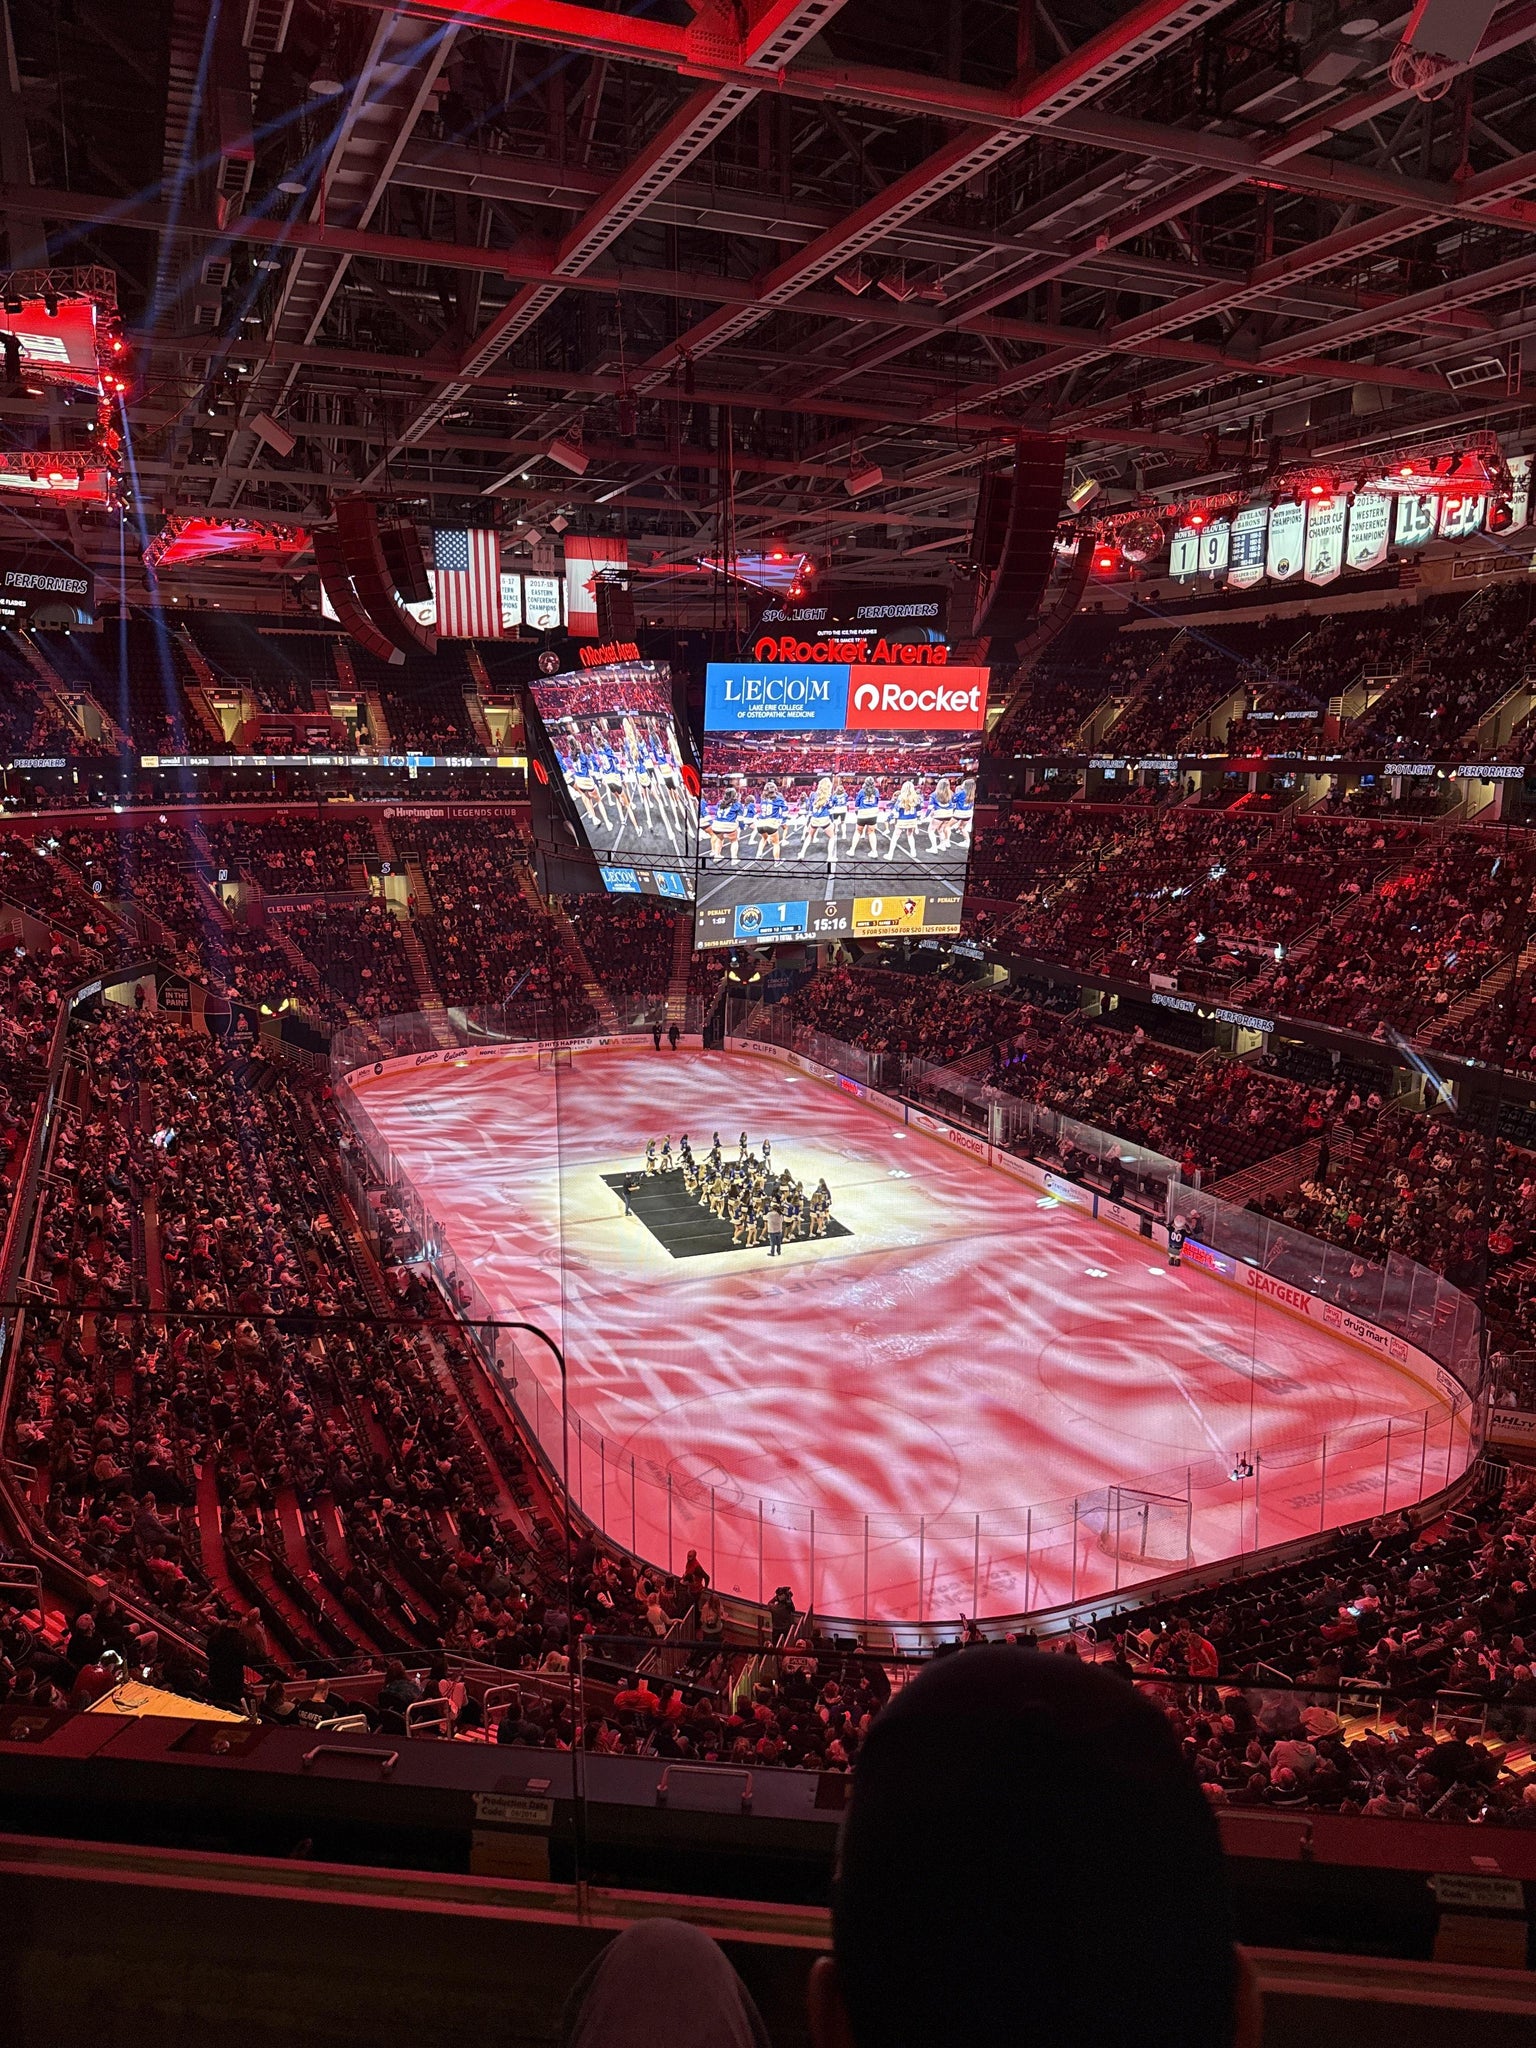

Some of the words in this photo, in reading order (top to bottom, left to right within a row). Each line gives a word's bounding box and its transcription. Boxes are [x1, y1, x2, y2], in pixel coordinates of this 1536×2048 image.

[1309, 515, 1331, 527] CALDER
[1332, 511, 1343, 522] CUP
[1356, 507, 1385, 519] WESTERN
[1403, 496, 1432, 533] 15
[1237, 518, 1261, 529] BARONS
[1271, 514, 1302, 527] CHAMPIONS
[1351, 518, 1388, 532] CONFERENCE
[1174, 529, 1197, 540] BOWER
[1202, 523, 1229, 534] GLOVER
[1308, 524, 1343, 539] CHAMPIONS
[1351, 530, 1385, 543] CHAMPIONS
[1180, 543, 1187, 570] 1
[1208, 537, 1218, 565] 9
[5, 572, 88, 595] PERFORMERS
[530, 580, 554, 588] 2017-18
[528, 604, 557, 612] CHAMPIONS
[762, 607, 828, 622] SPOLIGHT
[856, 603, 939, 619] PERFORMERS
[780, 637, 868, 663] Rocket
[871, 637, 949, 665] Arena
[881, 683, 981, 712] Rocket
[748, 703, 764, 712] LAKE
[765, 703, 779, 712] ERIE
[779, 703, 804, 712] COLLEGE
[737, 711, 746, 719] OF
[746, 711, 786, 719] OSTEOPATHIC
[787, 711, 815, 719] MEDICINE
[14, 758, 66, 769] PERFORMERS
[333, 757, 344, 765] 18
[373, 757, 379, 765] 5
[446, 757, 472, 767] 15:16
[1088, 759, 1126, 769] SPOTLIGHT
[1138, 760, 1179, 770] PERFORMERS
[1384, 763, 1435, 776] SPOTLIGHT
[1457, 765, 1525, 778] PERFORMERS
[396, 807, 444, 819] Huntington
[452, 808, 492, 817] LEGENDS
[494, 808, 517, 816] CLUB
[218, 869, 228, 881] N
[707, 908, 732, 917] PENALTY
[777, 903, 787, 922] 1
[870, 898, 883, 917] 0
[712, 917, 726, 925] 1:03
[813, 917, 847, 931] 15:16
[165, 998, 189, 1007] PAINT
[175, 992, 189, 1000] THE
[1151, 993, 1196, 1013] SPOTLIGHT
[1215, 1009, 1275, 1032] PERFORMERS
[544, 1040, 560, 1048] HITS
[560, 1039, 586, 1047] HAPPEN
[752, 1043, 777, 1056] CLIFFS
[956, 1132, 984, 1155] Rocket
[1170, 1231, 1182, 1243] 00
[1246, 1269, 1312, 1315] SEATGEEK
[1343, 1317, 1366, 1337] drug
[1365, 1329, 1389, 1347] mart
[483, 1795, 528, 1809] Production
[528, 1800, 549, 1810] Date
